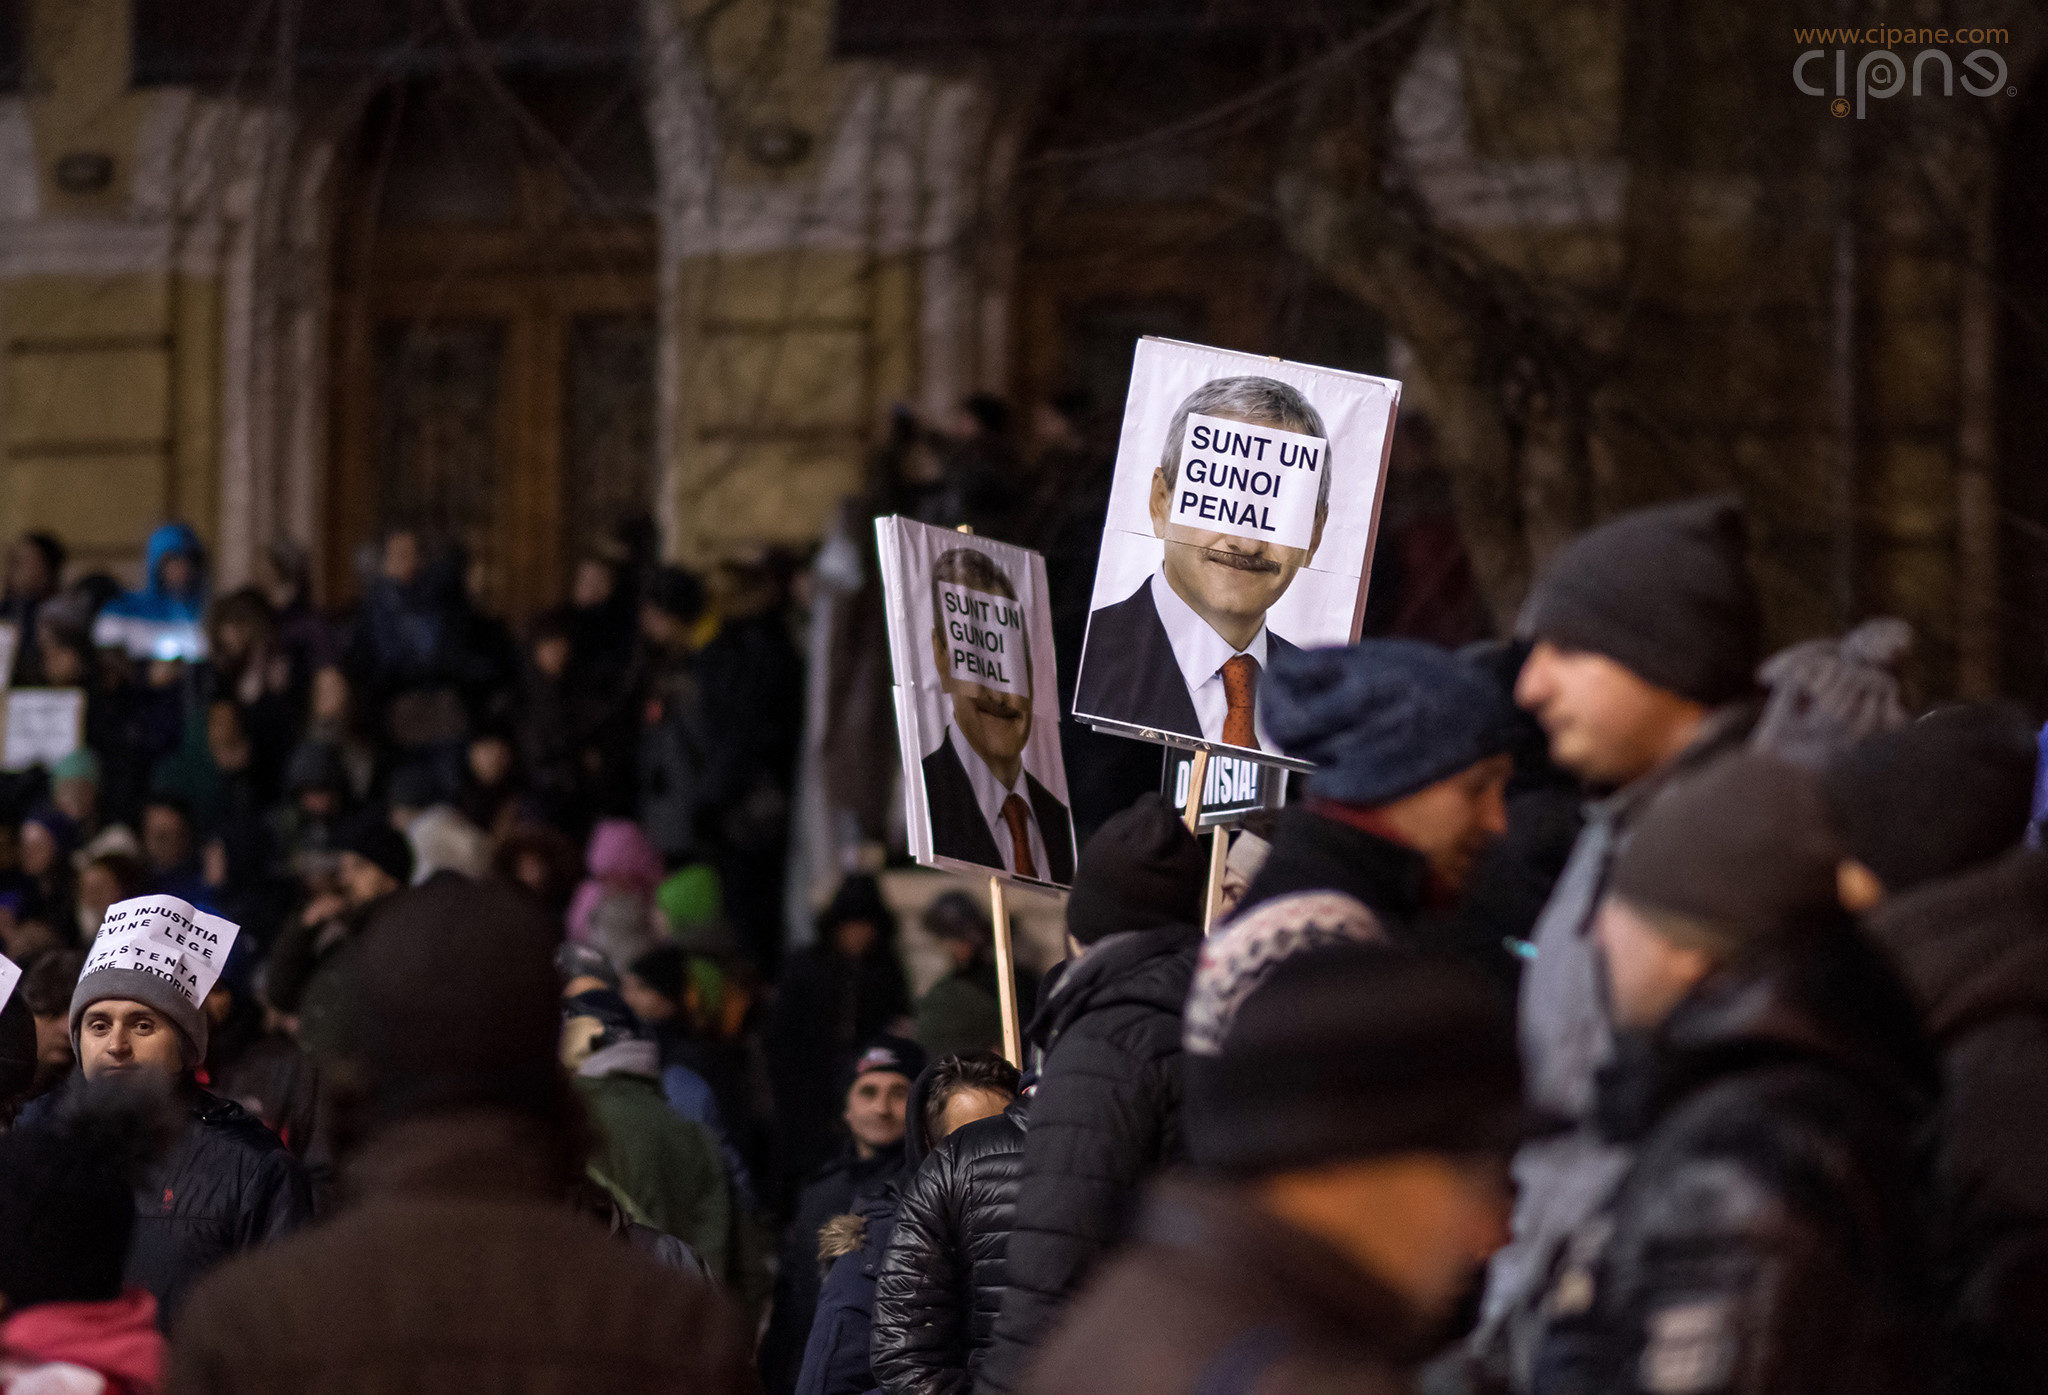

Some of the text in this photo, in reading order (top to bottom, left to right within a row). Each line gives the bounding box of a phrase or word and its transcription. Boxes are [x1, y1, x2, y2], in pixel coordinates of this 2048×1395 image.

[1191, 425, 1319, 471] SUNT UN
[1186, 459, 1281, 498] GUNOI
[1180, 491, 1276, 531] PENAL
[944, 592, 1019, 630] SUNT UN
[950, 621, 1004, 654] GUNOI
[954, 649, 1010, 683] PENAL
[1175, 756, 1258, 809] DMISIA!
[103, 907, 218, 944] ND INJUSTITIA
[164, 926, 213, 959] LEGE
[83, 945, 197, 986] EZISTENTA
